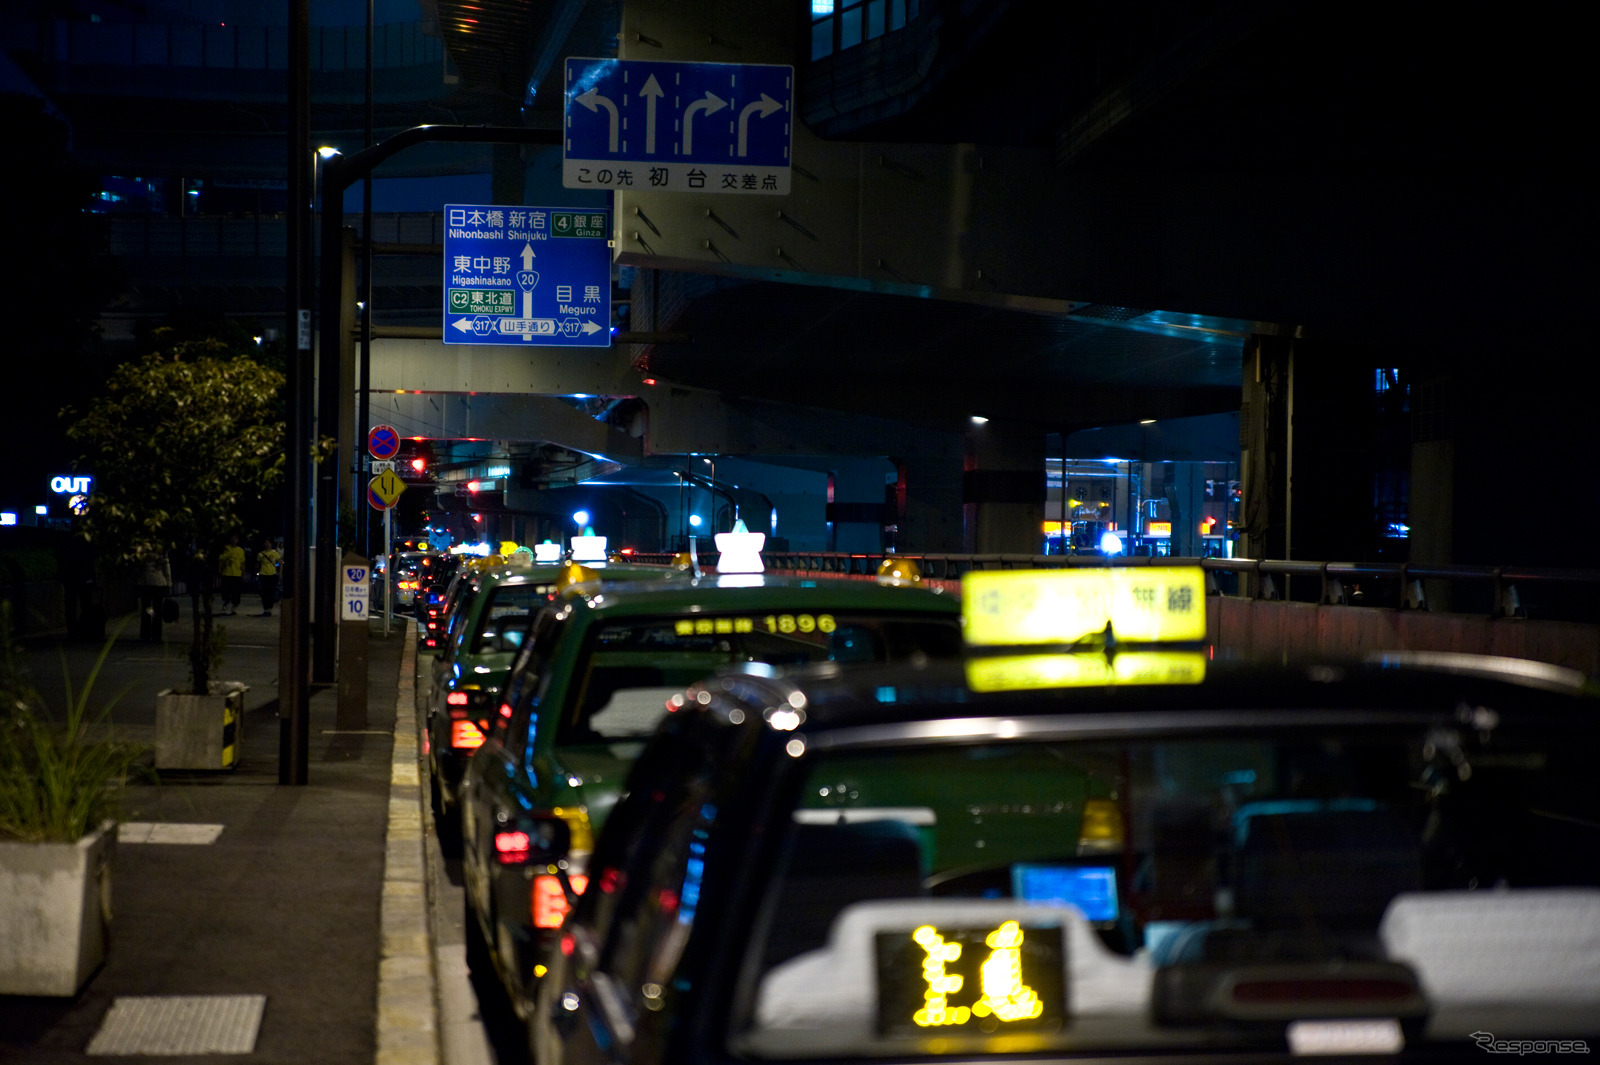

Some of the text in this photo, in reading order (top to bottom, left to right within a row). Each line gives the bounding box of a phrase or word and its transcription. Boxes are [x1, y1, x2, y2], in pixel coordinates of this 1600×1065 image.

[577, 168, 633, 185] この先
[722, 173, 778, 191] 交差点
[450, 209, 546, 229] 日本橋 新宿
[558, 216, 568, 229] 4
[573, 214, 604, 229] 銀座
[449, 229, 547, 242] Nihonbashi Shinjuku
[576, 229, 601, 237] Ginza
[453, 255, 511, 275] 東中野
[452, 275, 512, 286] Higashinakano
[521, 274, 534, 286] 20
[453, 293, 468, 304] C2
[471, 291, 513, 306] 東北道
[556, 285, 601, 303] 目黒
[470, 305, 513, 313] TOHOKU EXPWY
[560, 305, 596, 316] Meguro
[474, 320, 490, 331] 317
[504, 321, 550, 333] 山手通り
[564, 322, 580, 333] 317
[50, 476, 92, 493] OUT
[351, 569, 363, 580] 20
[348, 599, 363, 613] 10
[763, 613, 837, 634] 1896
